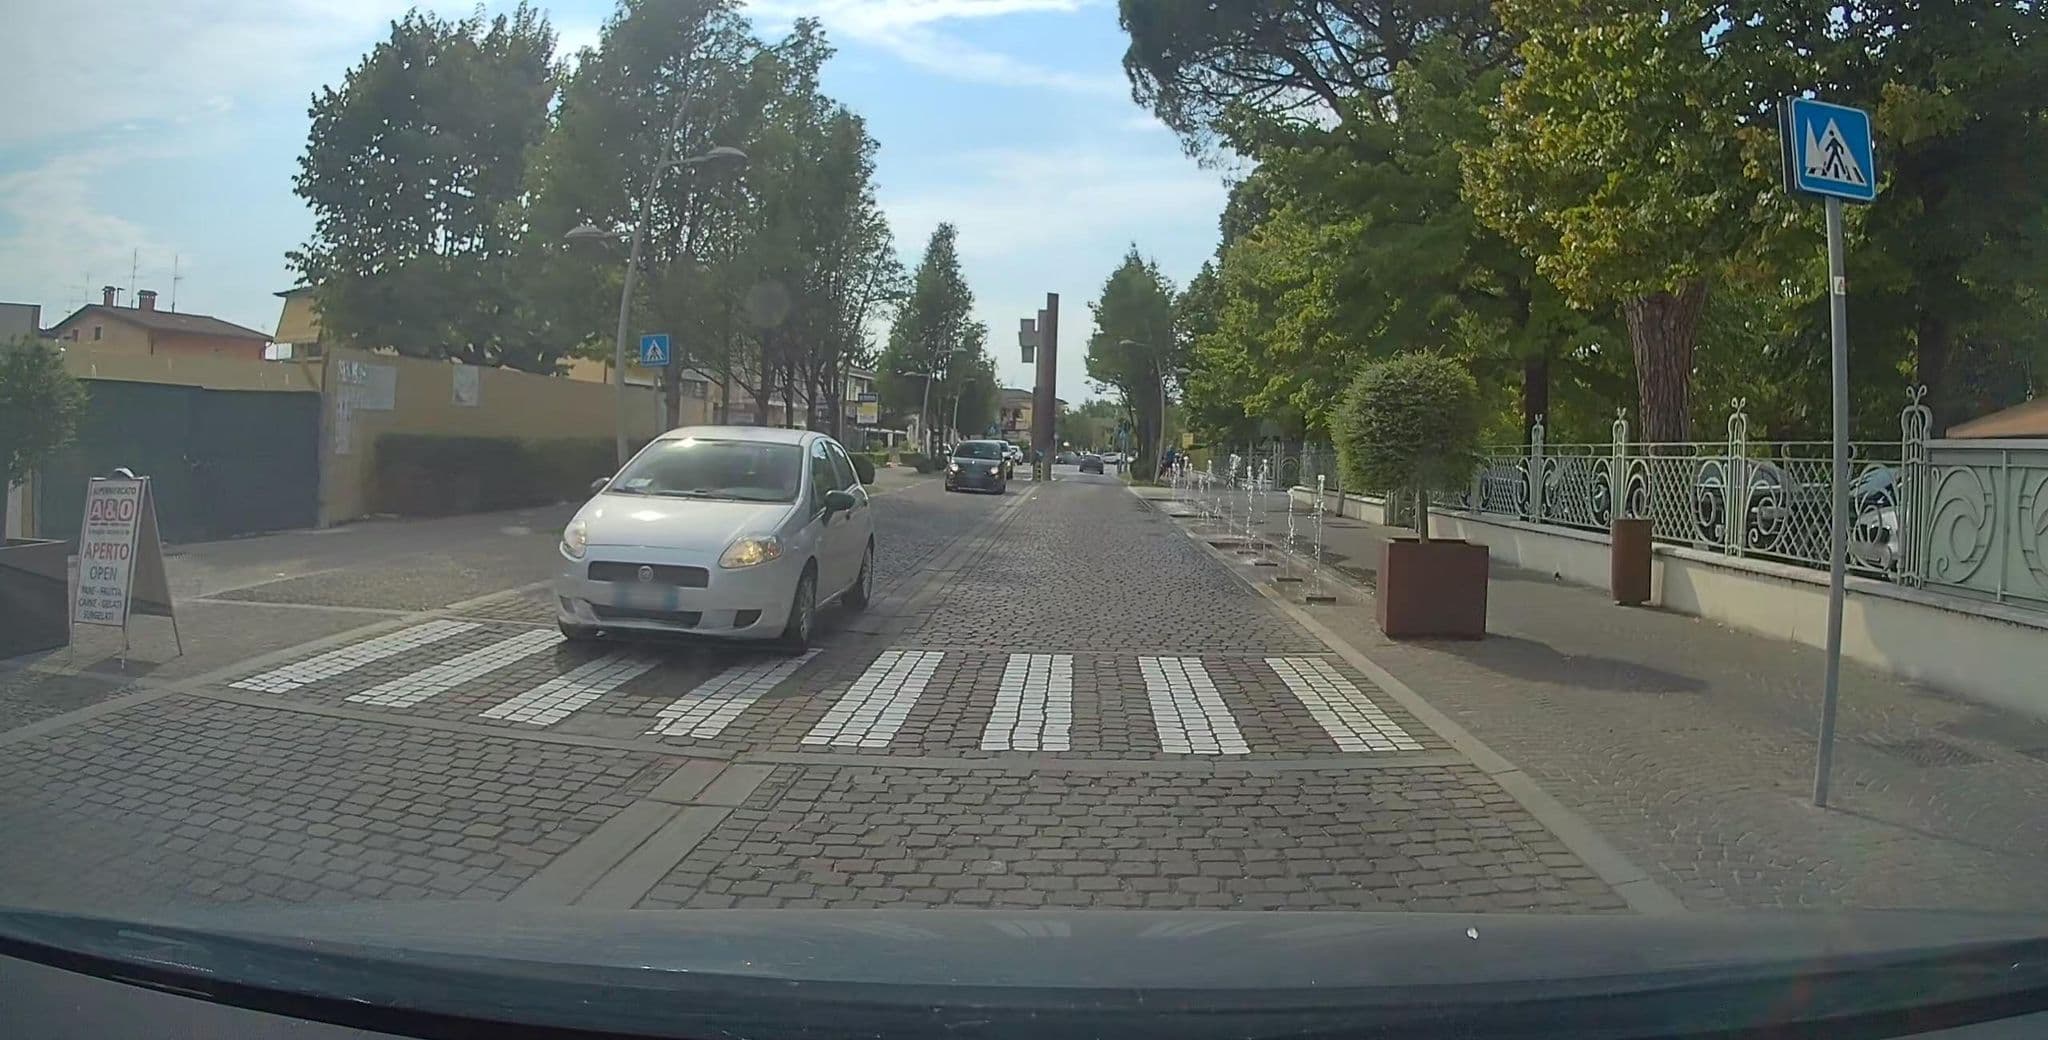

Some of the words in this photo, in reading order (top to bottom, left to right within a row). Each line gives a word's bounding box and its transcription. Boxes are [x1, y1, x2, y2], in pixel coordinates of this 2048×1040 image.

[89, 498, 134, 521] A&O
[84, 541, 130, 560] APERTO
[89, 566, 118, 581] OPEN
